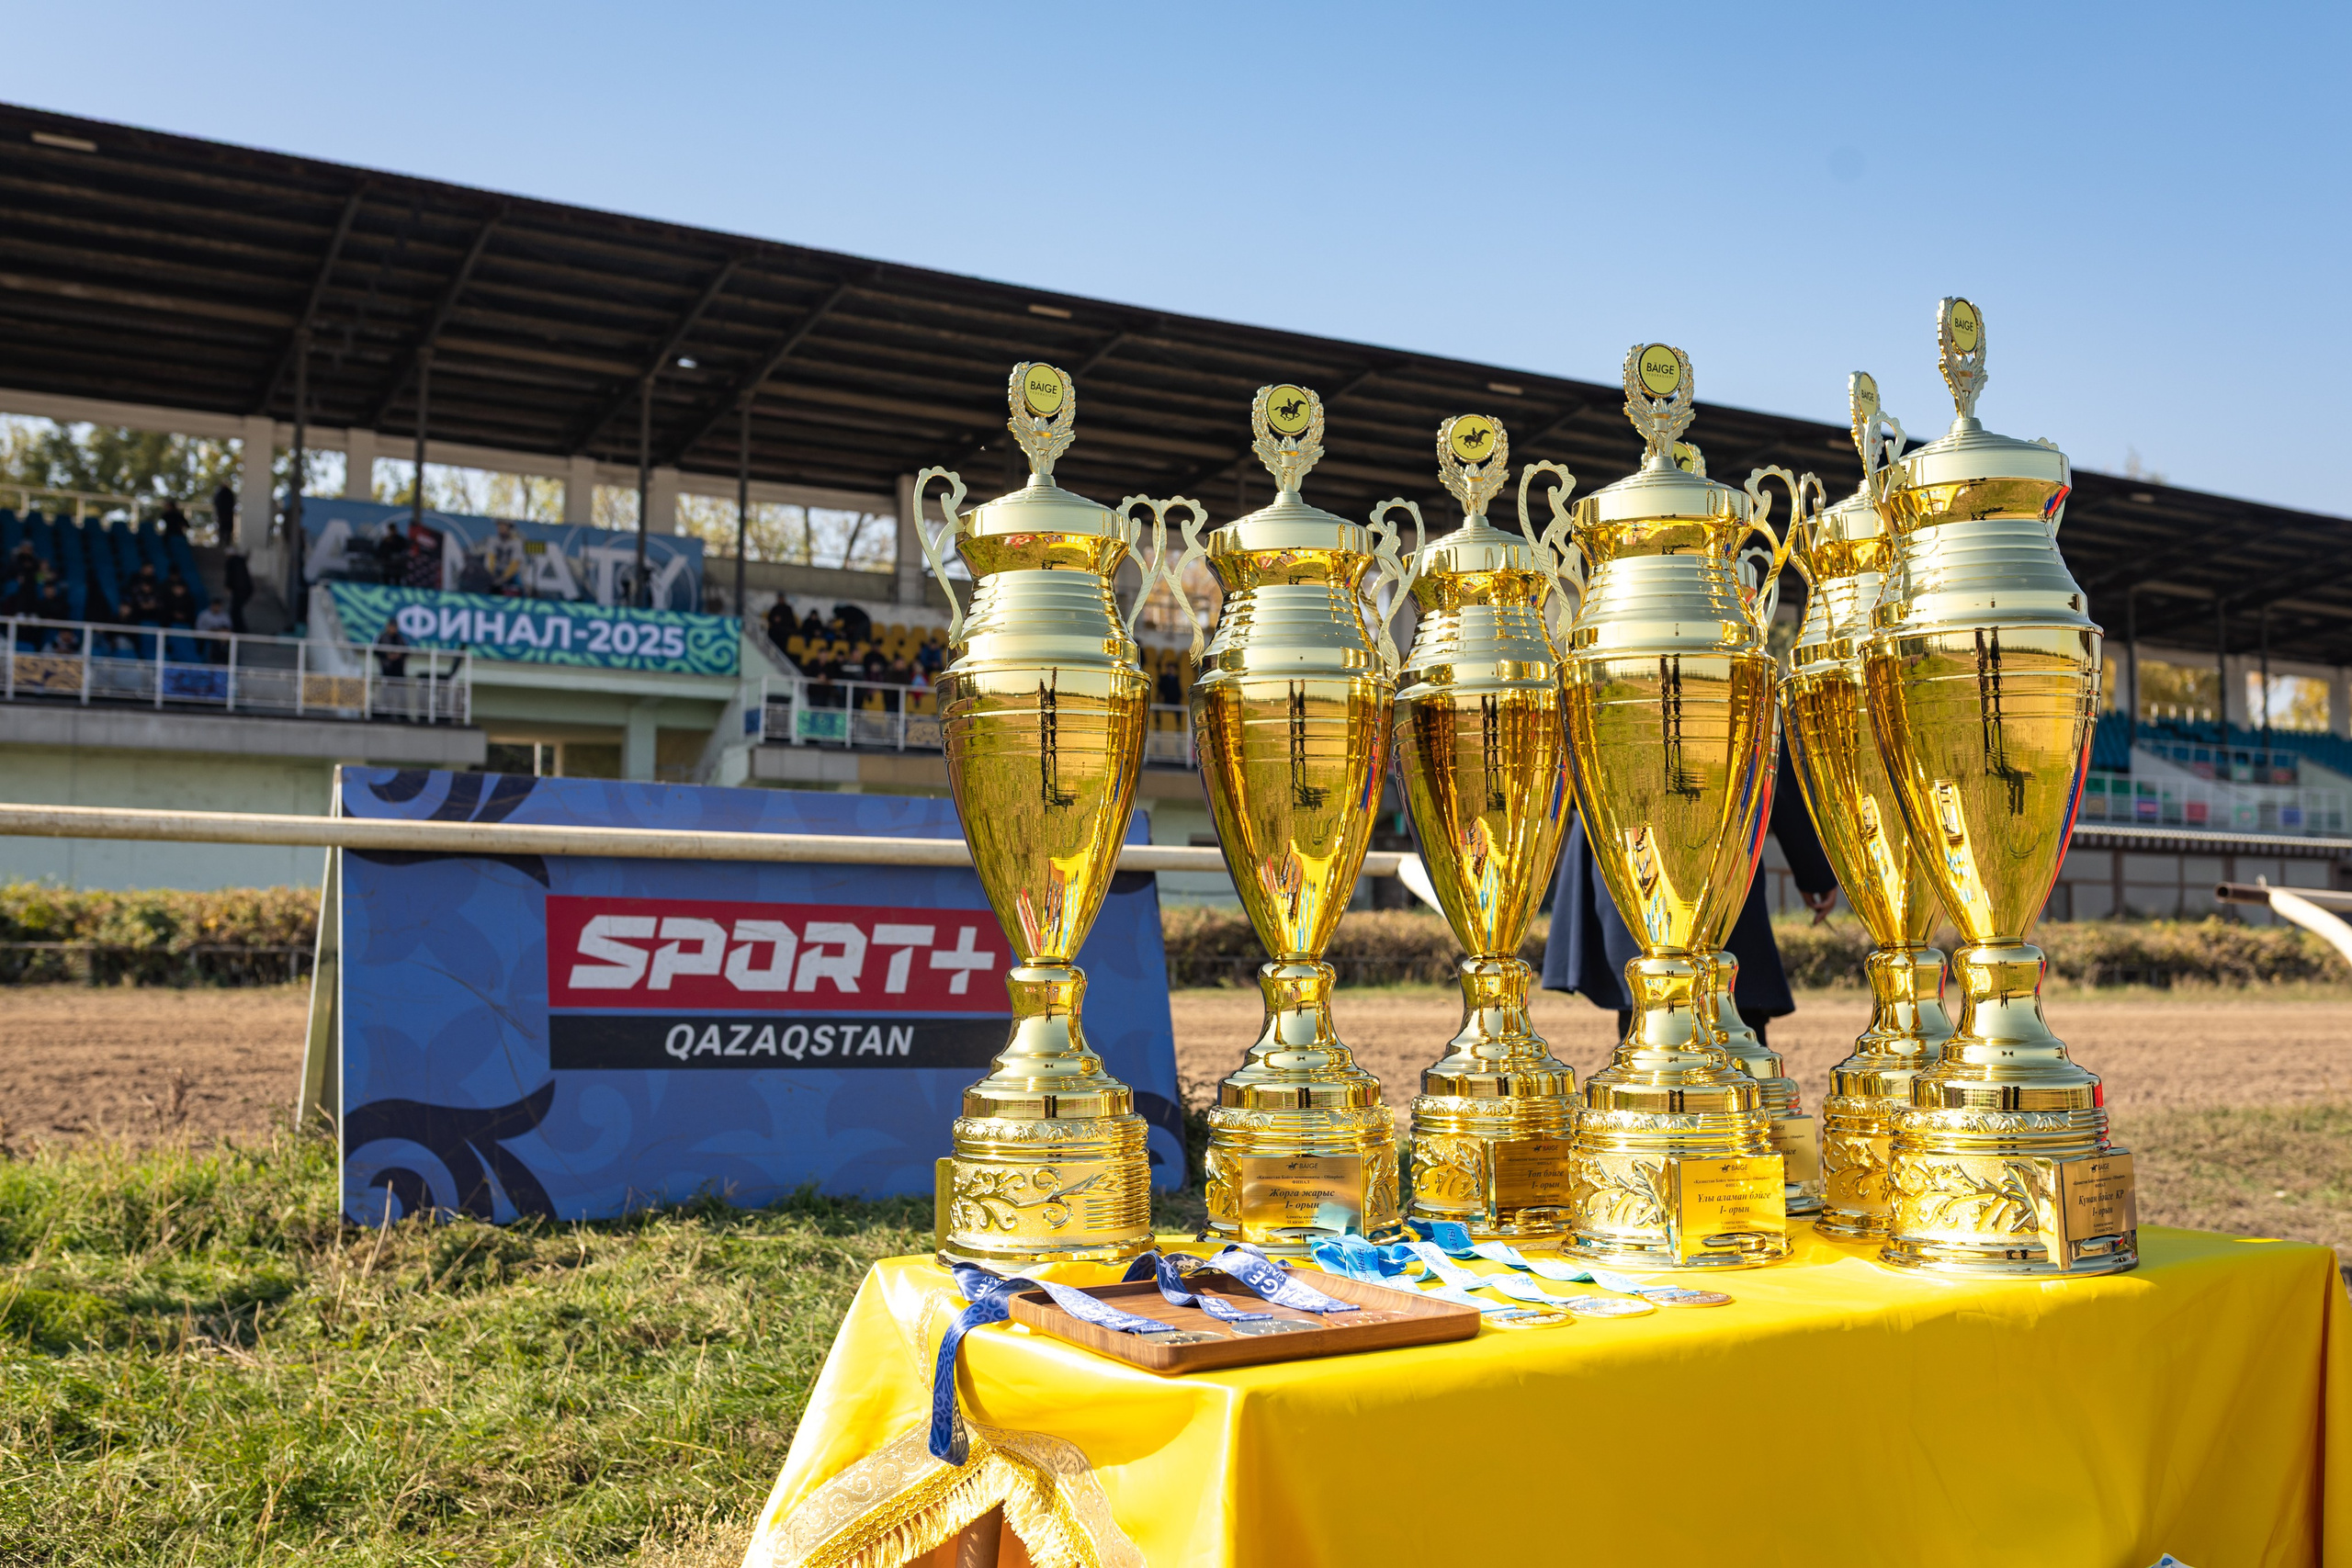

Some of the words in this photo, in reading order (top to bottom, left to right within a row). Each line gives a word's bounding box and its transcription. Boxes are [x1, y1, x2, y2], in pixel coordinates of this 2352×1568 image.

[396, 604, 686, 658] ФИНАЛ-2025
[664, 1023, 915, 1061] QAZAQSTAN
[1295, 1202, 1319, 1211] орын
[1728, 1206, 1750, 1215] орын
